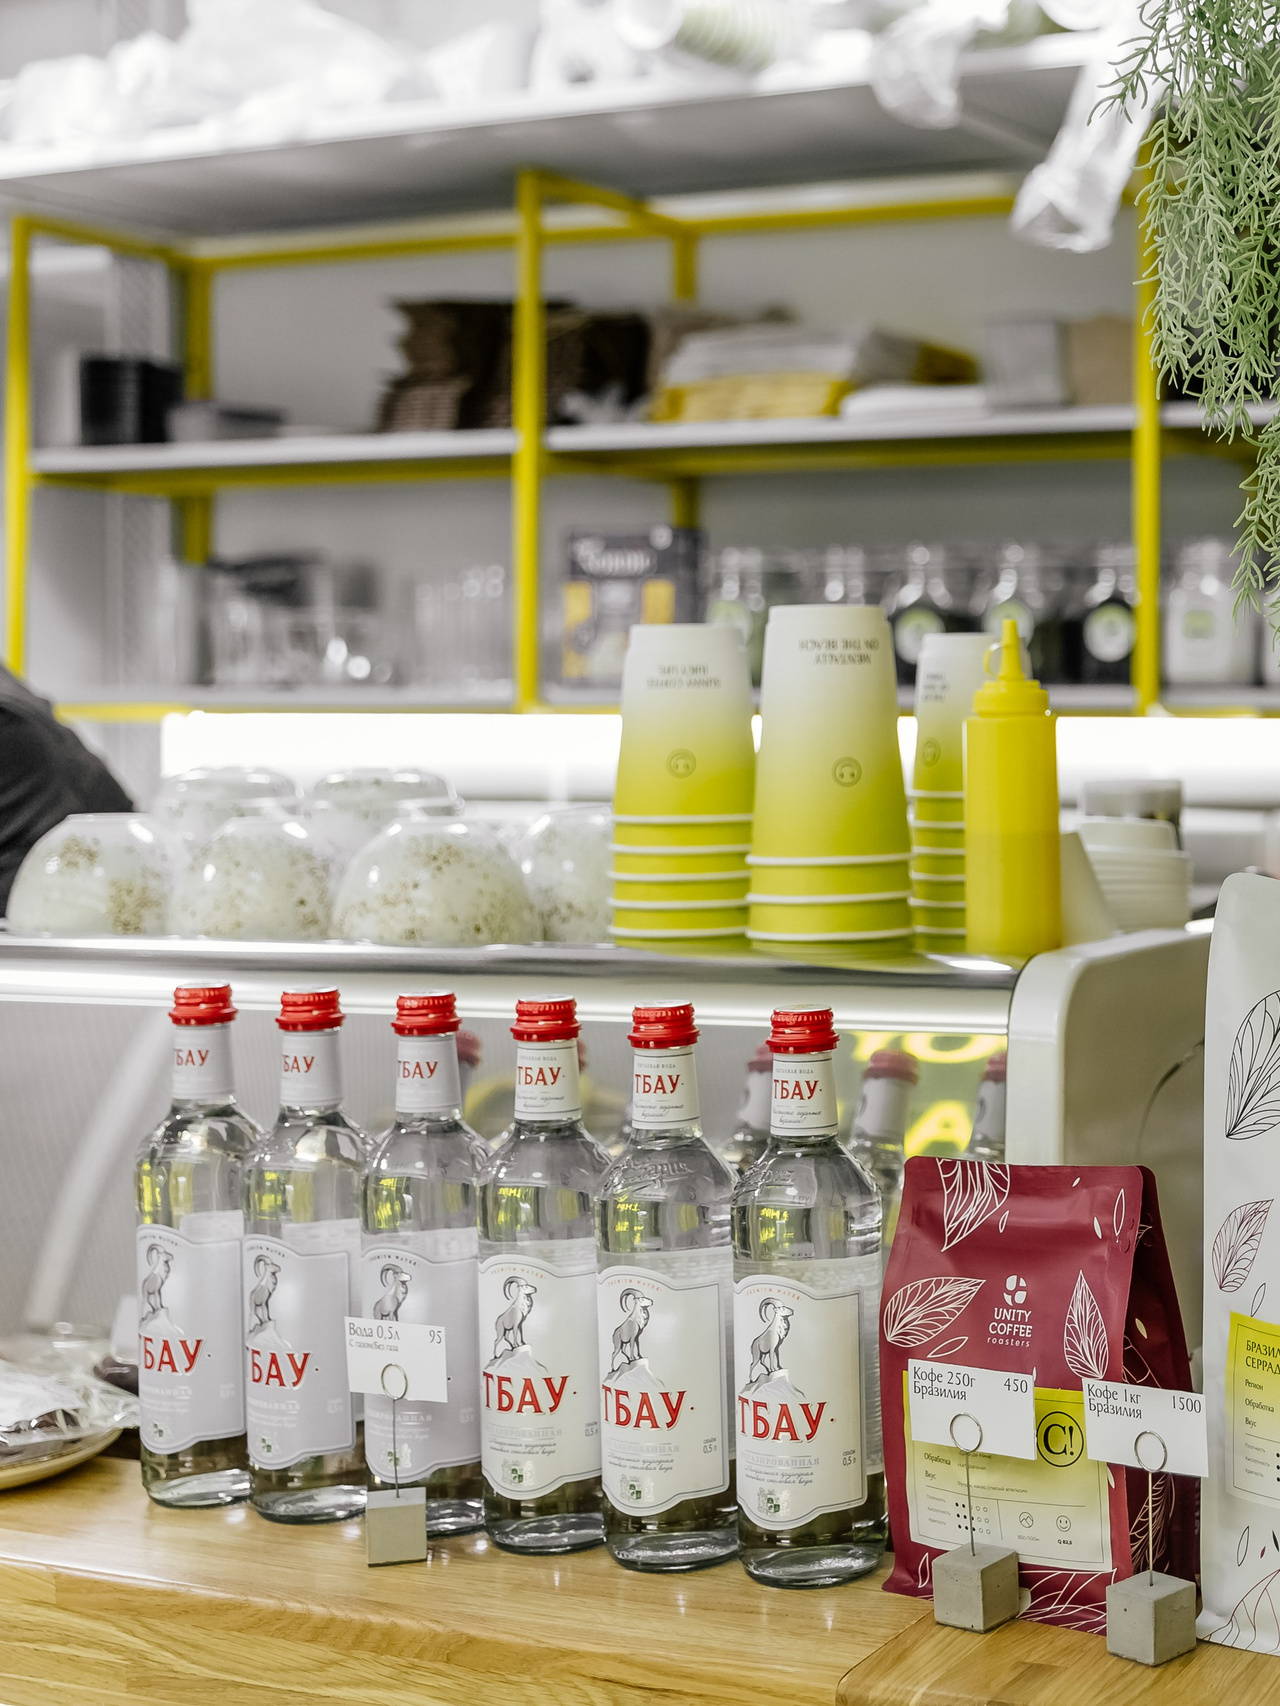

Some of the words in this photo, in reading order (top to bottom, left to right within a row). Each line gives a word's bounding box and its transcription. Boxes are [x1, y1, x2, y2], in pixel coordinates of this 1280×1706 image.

[799, 638, 838, 651] BEACH
[863, 638, 880, 651] ON
[814, 653, 872, 665] MENTALLY
[646, 678, 684, 689] COFFEE
[686, 677, 722, 689] SUNNY
[174, 1048, 210, 1067] БАУ
[517, 1065, 562, 1086] ТБАУ
[634, 1073, 681, 1095] ТБАУ
[773, 1078, 820, 1101] ТБАУ
[994, 1307, 1032, 1323] UNITY
[348, 1322, 374, 1338] Вода
[428, 1329, 443, 1345] 95
[988, 1321, 1033, 1338] COFFEE
[987, 1336, 1030, 1348] roasters
[138, 1333, 204, 1374] БАУ
[247, 1346, 311, 1388] БАУ
[913, 1366, 944, 1387] Кофе
[947, 1371, 976, 1388] 250г
[1003, 1378, 1029, 1394] 450
[1244, 1378, 1264, 1391] Регион
[482, 1370, 570, 1414] ТБАУ
[913, 1380, 967, 1401] Бразилия
[1087, 1383, 1119, 1404] Кофе
[601, 1383, 687, 1429] ТБАУ
[1088, 1397, 1143, 1419] Бразилия
[1172, 1395, 1202, 1414] 1500
[1244, 1397, 1275, 1413] Обработка
[738, 1394, 827, 1442] ТБАУ
[1244, 1416, 1257, 1429] Вкус
